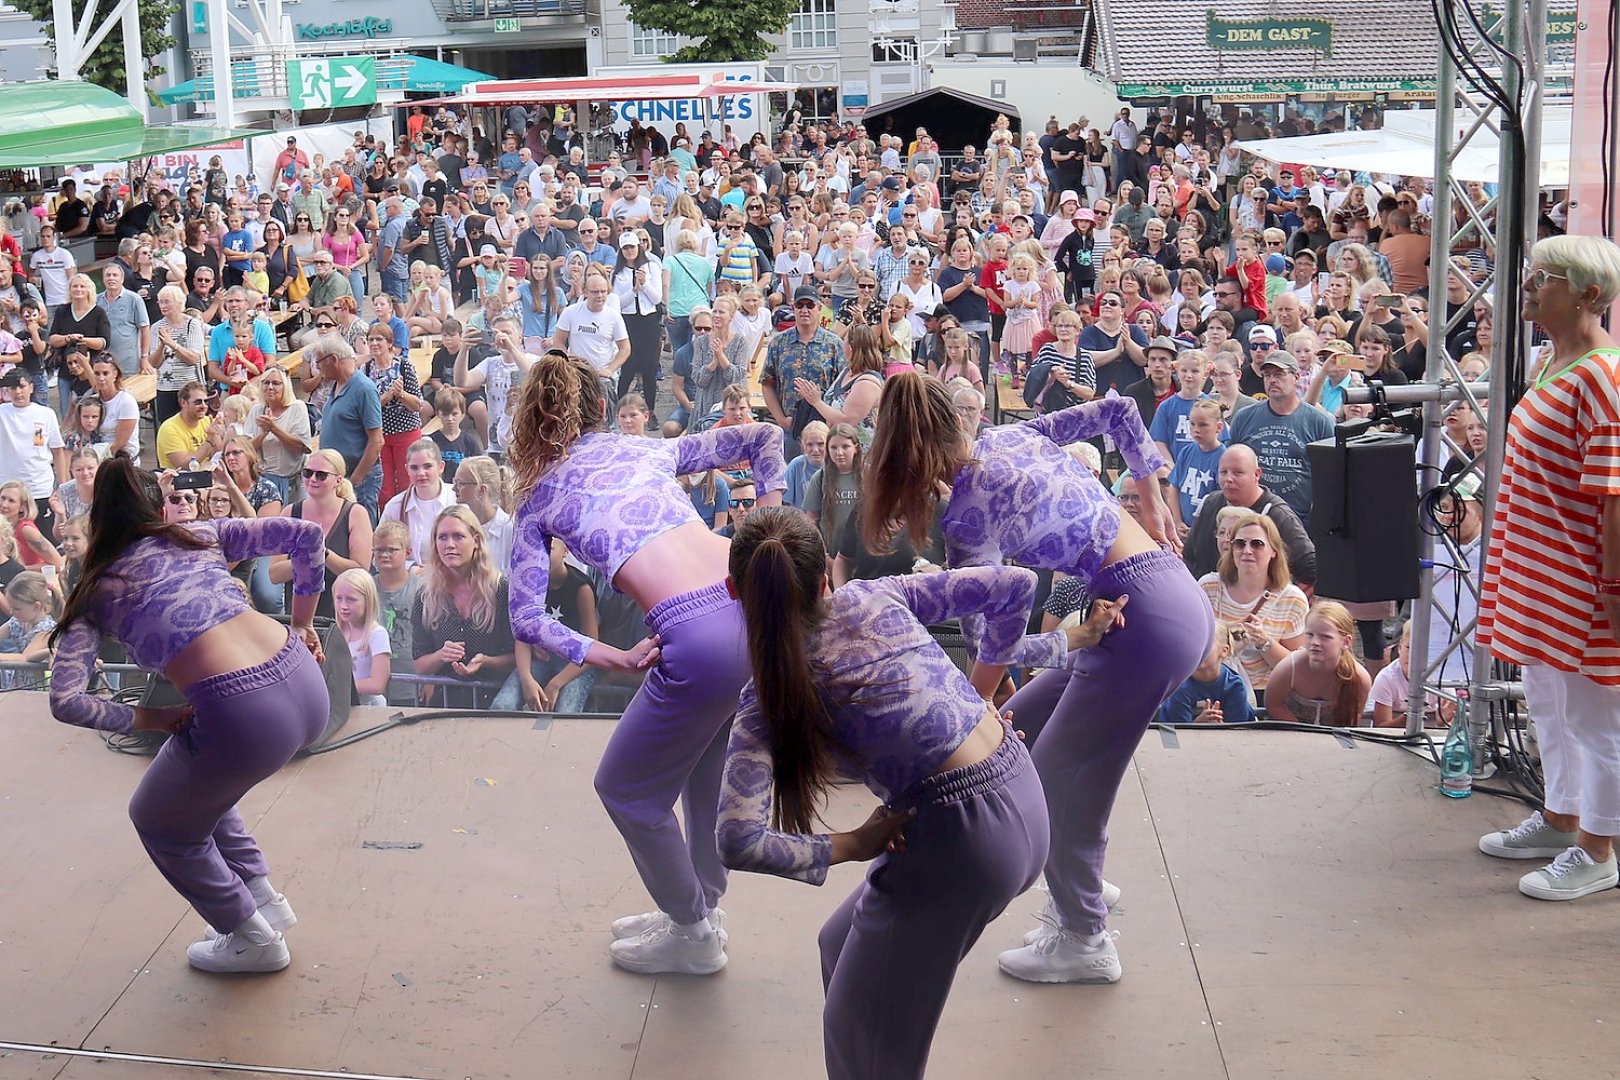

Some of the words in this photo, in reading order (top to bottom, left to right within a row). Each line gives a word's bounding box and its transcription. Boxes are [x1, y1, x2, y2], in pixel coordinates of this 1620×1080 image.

[296, 16, 393, 39] Kochlöffel
[1227, 29, 1263, 42] DEM
[1267, 27, 1312, 41] GAST
[1182, 83, 1254, 96] Currywurst
[1304, 81, 1337, 91] Thür.
[1339, 80, 1401, 91] Bratwurst
[608, 97, 753, 122] SCHNELLES
[164, 154, 198, 167] BIN
[1277, 456, 1304, 469] FALLS
